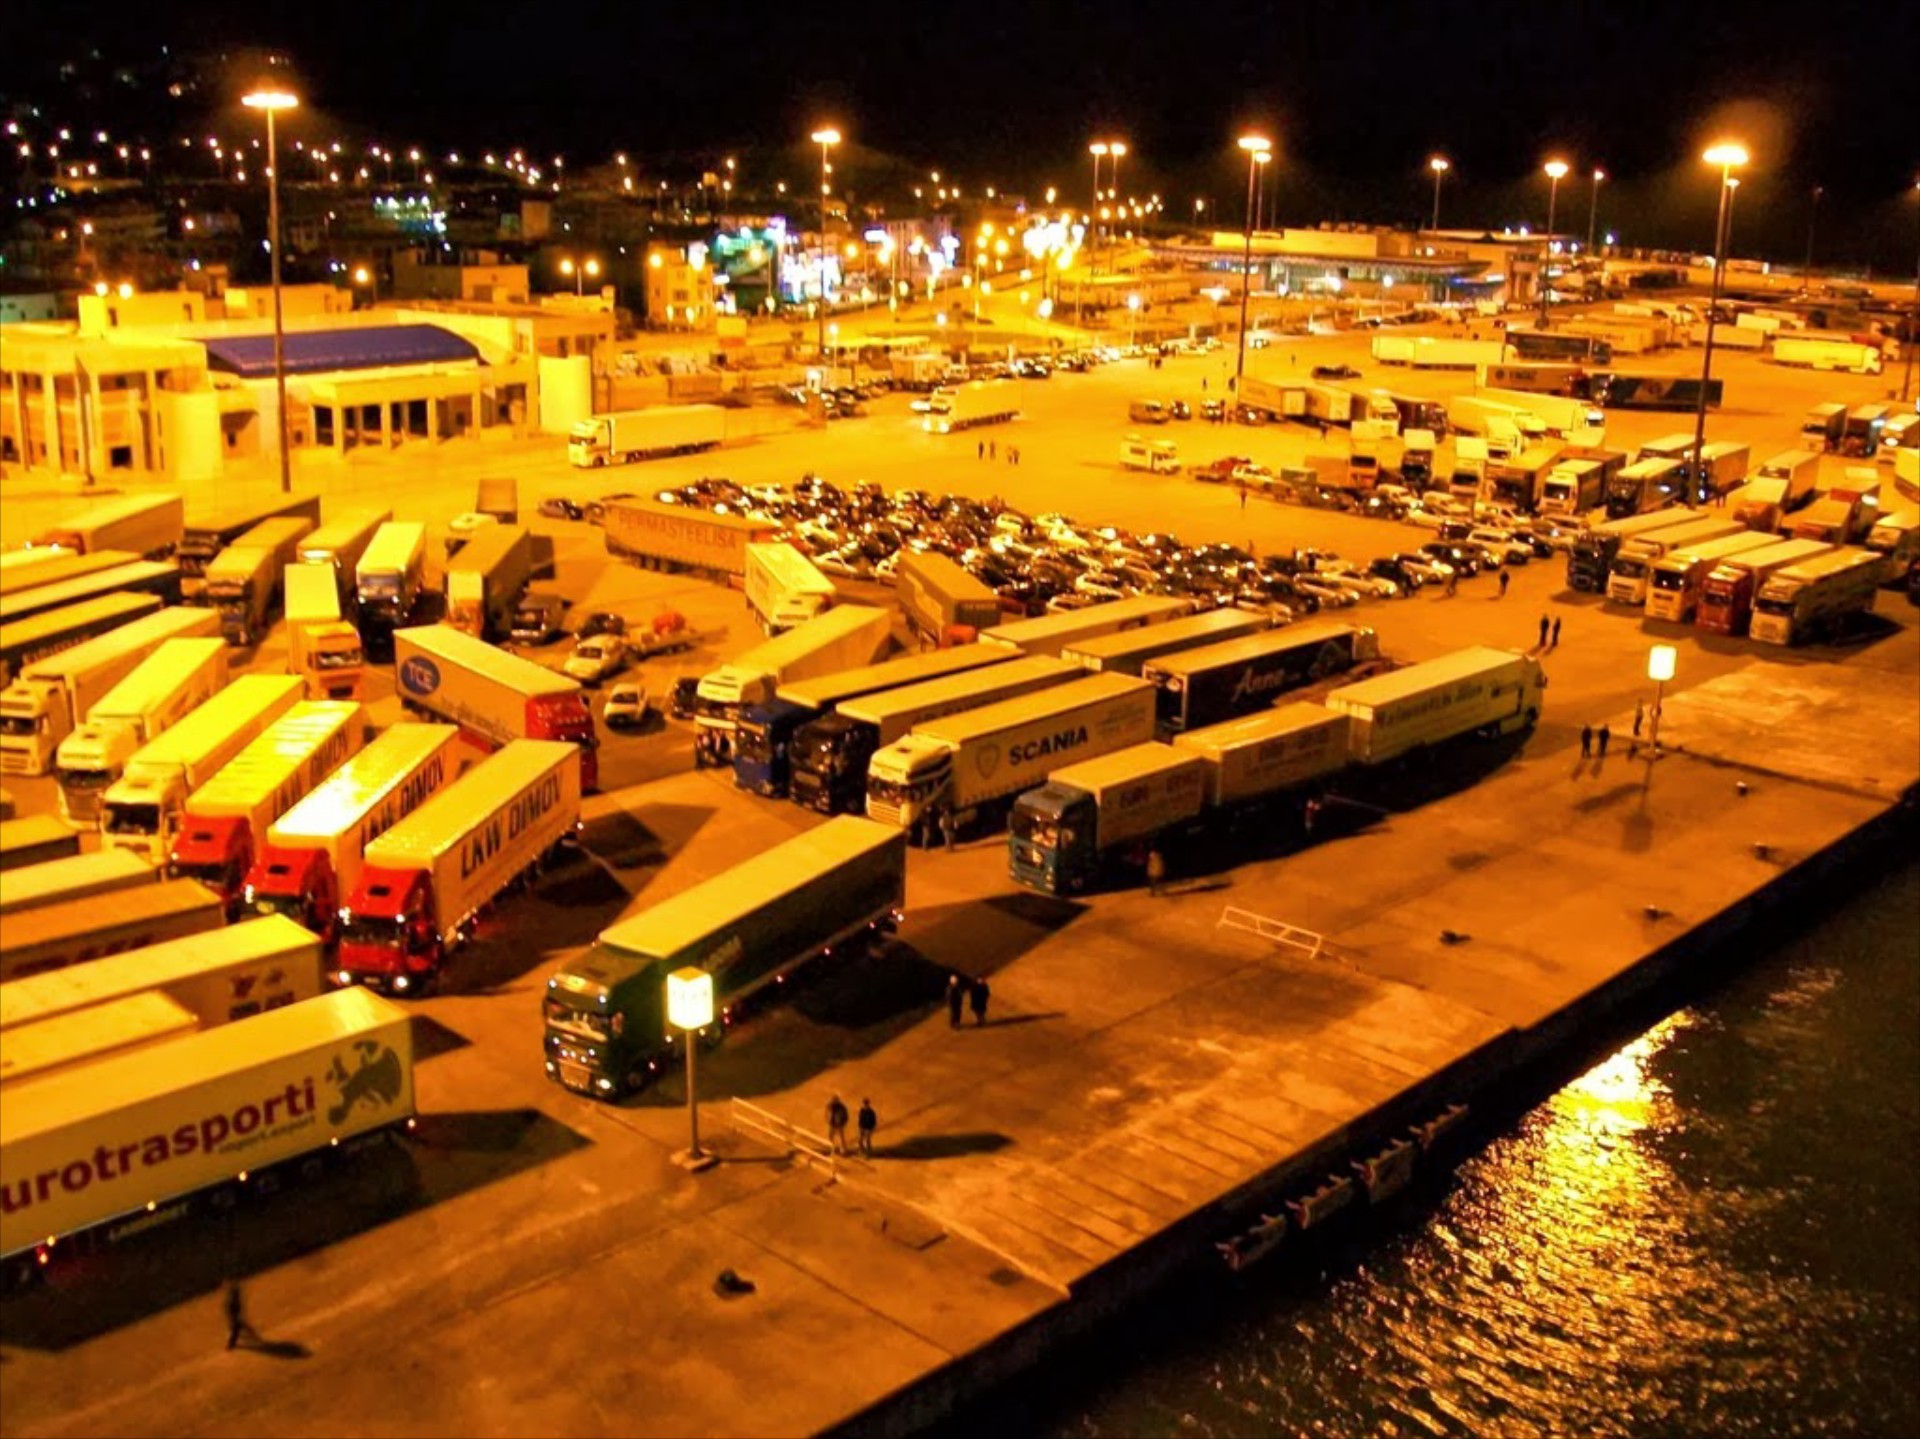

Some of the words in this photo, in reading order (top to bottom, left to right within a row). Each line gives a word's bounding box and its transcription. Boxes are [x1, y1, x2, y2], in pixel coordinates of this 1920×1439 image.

[1009, 725, 1088, 766] SCANIA
[461, 815, 502, 880] LKW
[509, 771, 562, 840] DIMOV
[0, 1075, 316, 1215] urotrasporti
